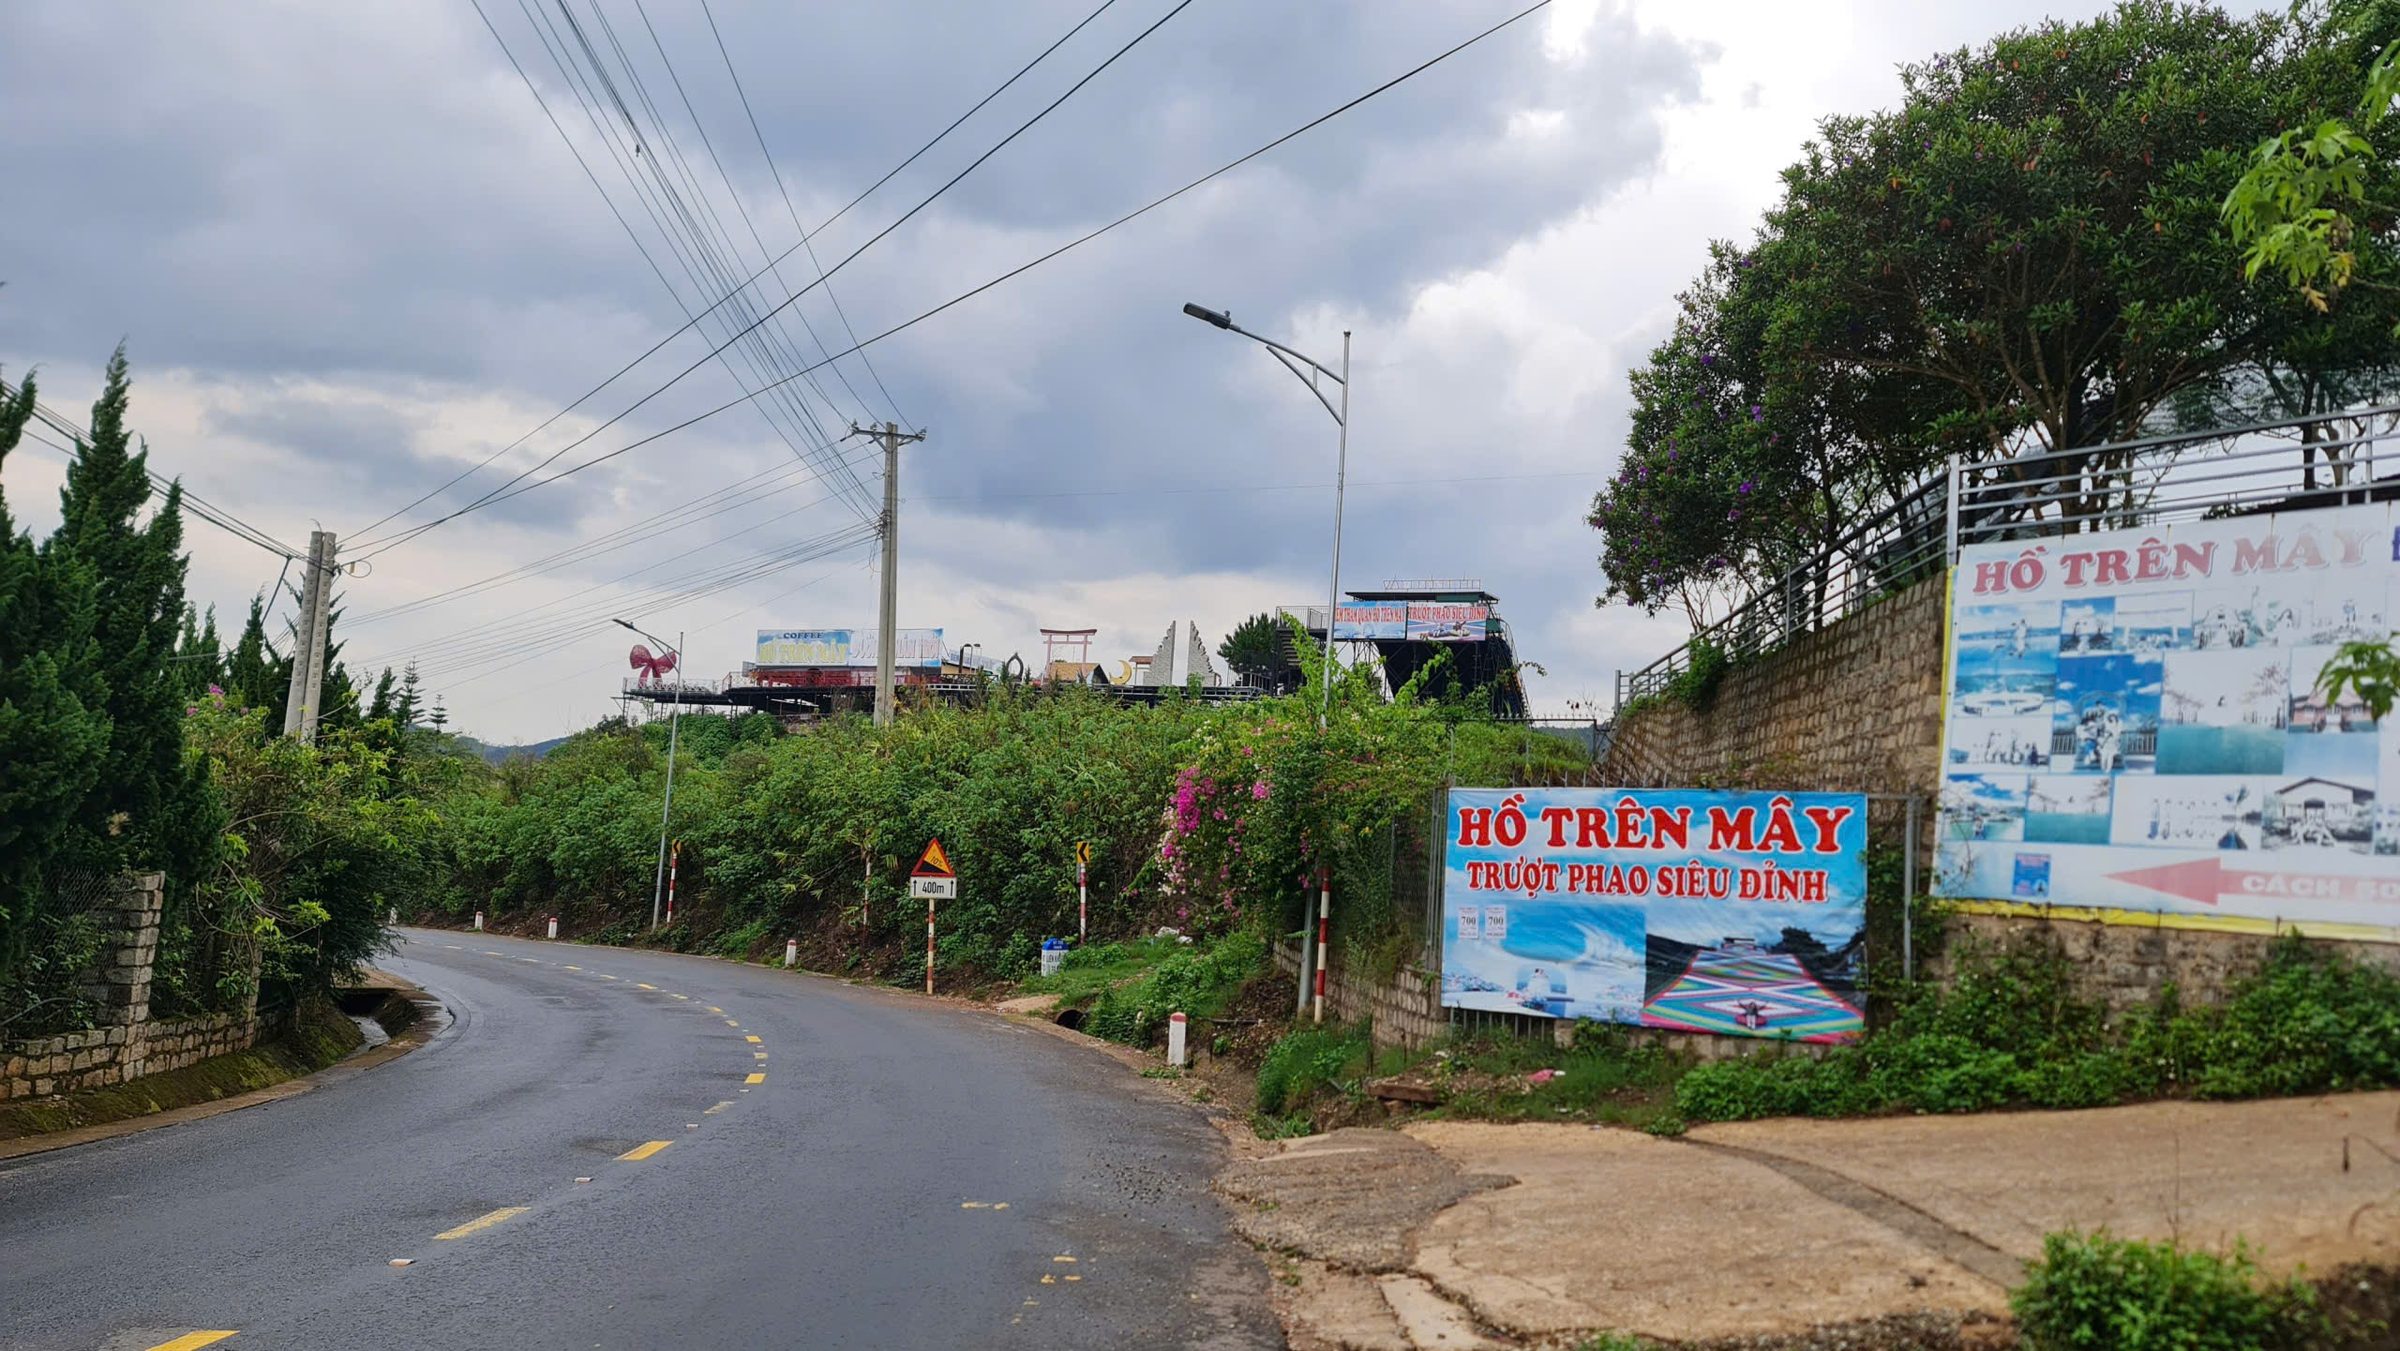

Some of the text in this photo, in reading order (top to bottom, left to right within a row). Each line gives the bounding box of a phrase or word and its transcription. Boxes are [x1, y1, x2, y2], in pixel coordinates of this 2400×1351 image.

[1973, 545, 2047, 593] HỒ
[2060, 537, 2217, 586] TRÊN
[2231, 523, 2379, 575] MÂY
[1457, 793, 1852, 852] HỒ TRÊN MÂY
[922, 881, 945, 894] 400m
[1466, 856, 1828, 901] TRƯỢT PHAO SIÊU ĐỈNH
[1461, 916, 1477, 925] 700
[1488, 916, 1504, 926] 700
